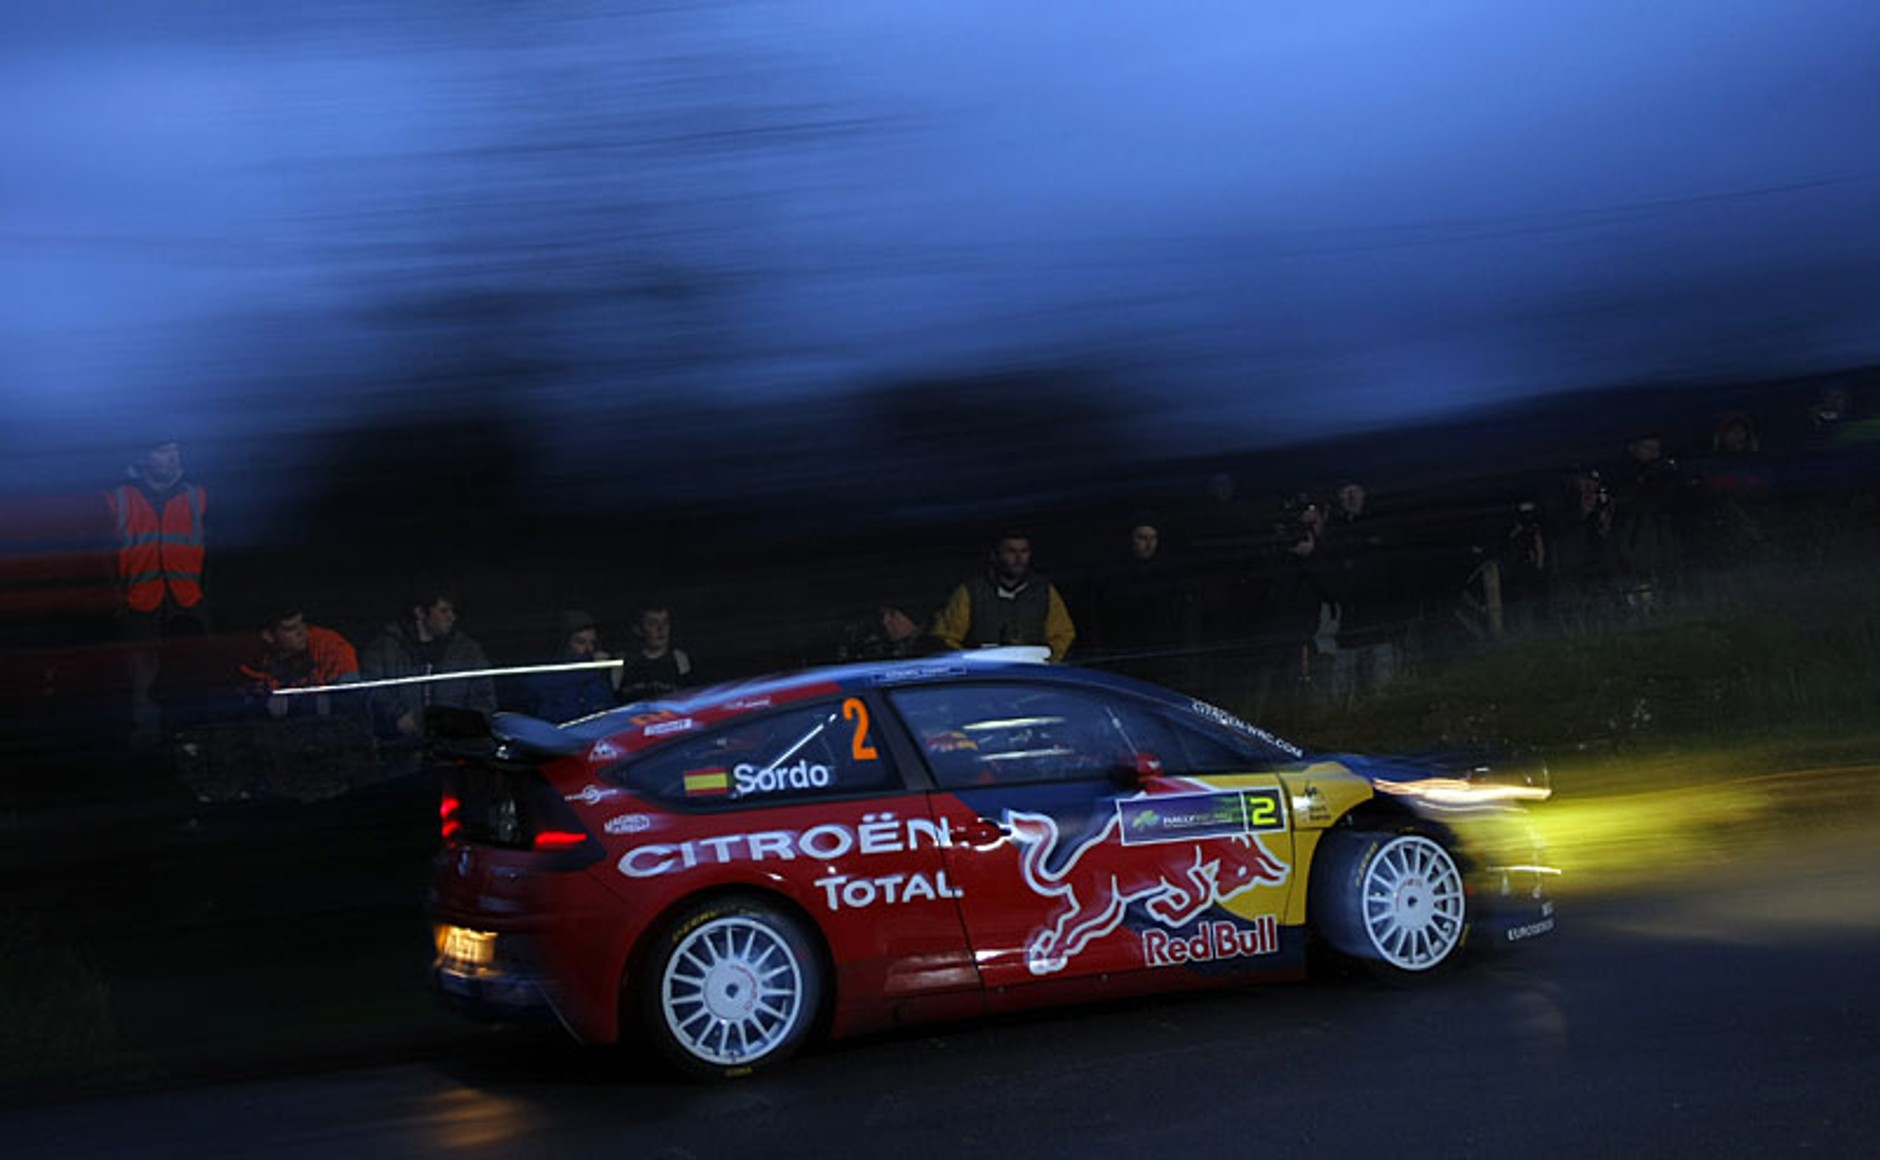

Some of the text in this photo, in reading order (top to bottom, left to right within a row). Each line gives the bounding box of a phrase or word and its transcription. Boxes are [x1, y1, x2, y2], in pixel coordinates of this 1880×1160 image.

[841, 696, 878, 761] 2
[732, 759, 830, 794] Sordo
[1250, 796, 1278, 826] 2
[617, 812, 951, 878] CITROËN
[813, 867, 965, 912] TOTAL
[1142, 914, 1280, 967] Red Bull
